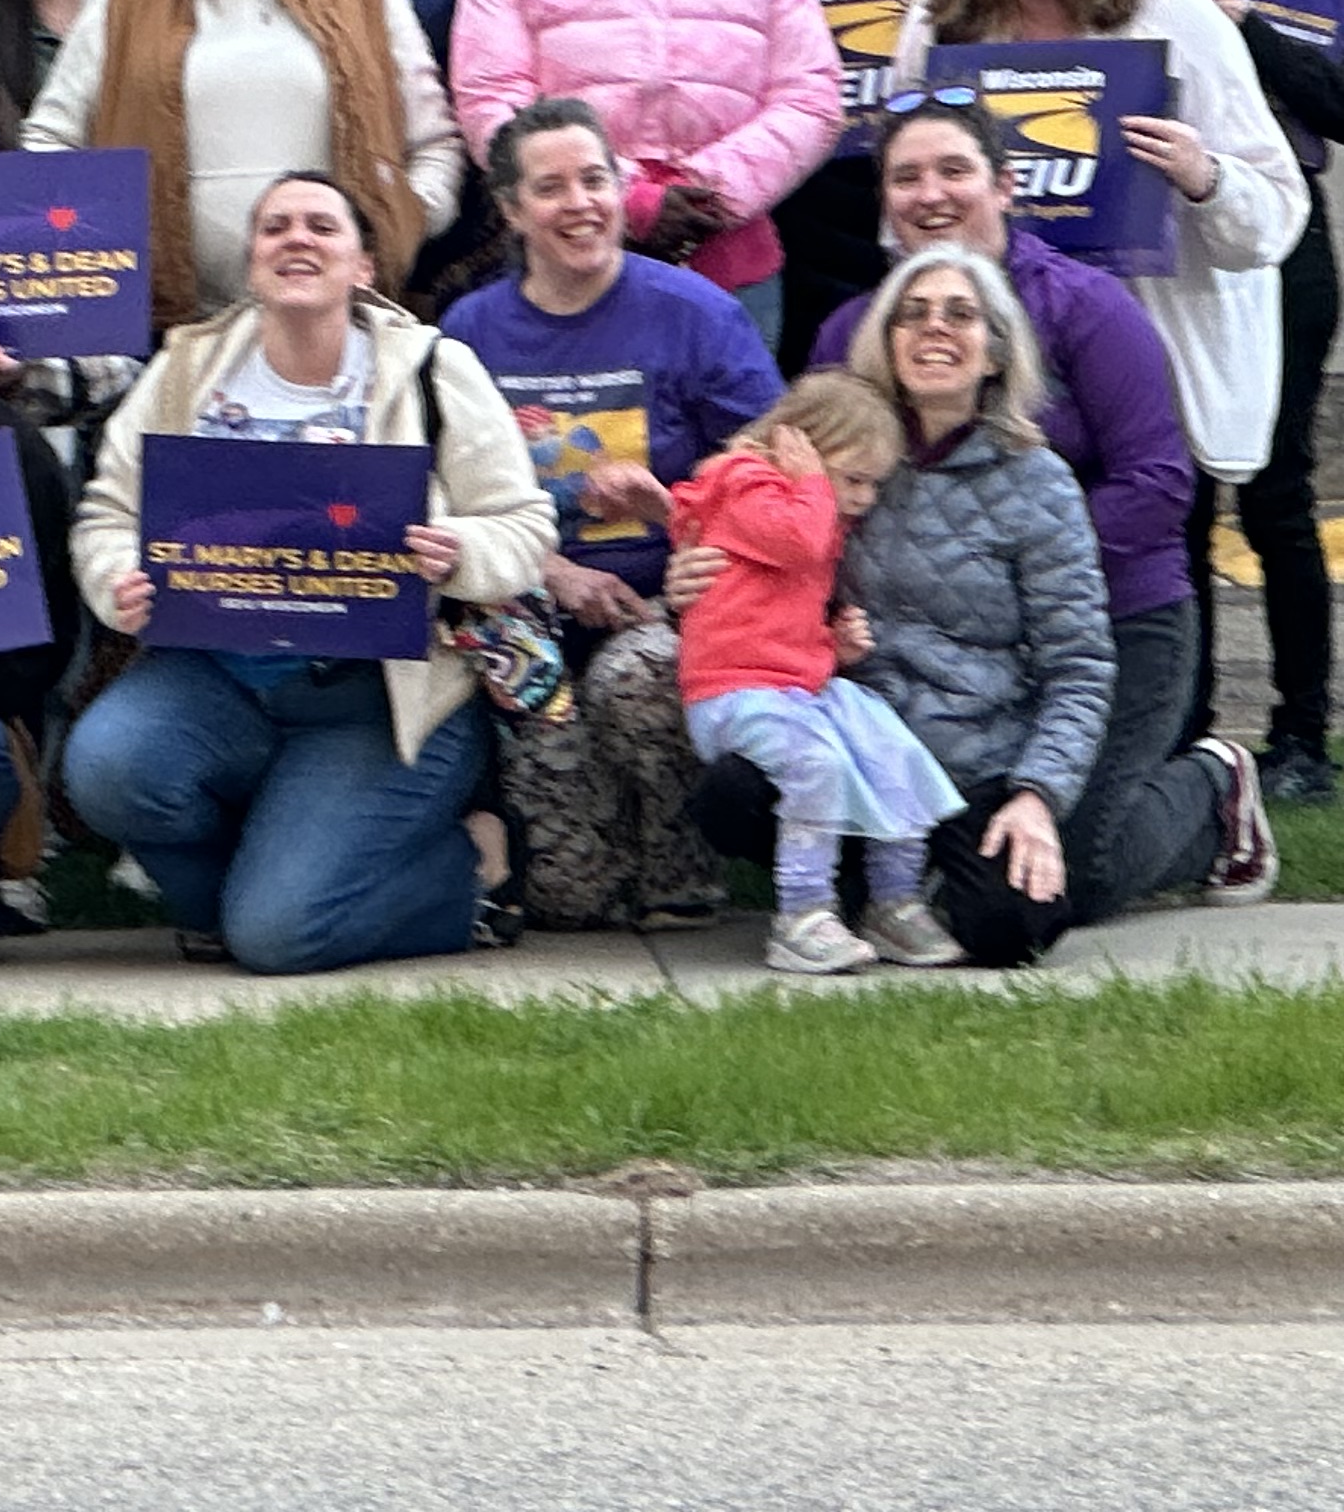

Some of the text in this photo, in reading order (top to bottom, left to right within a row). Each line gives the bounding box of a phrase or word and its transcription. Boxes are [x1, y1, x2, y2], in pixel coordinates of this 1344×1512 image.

[980, 65, 1107, 89] Wisconsin
[1007, 157, 1099, 197] EIU
[28, 252, 51, 274] &
[54, 250, 138, 272] DEAN
[10, 275, 119, 299] UNITED
[148, 541, 419, 573] ST. MARY'S & DEAN
[168, 570, 399, 599] NURSES UNITED
